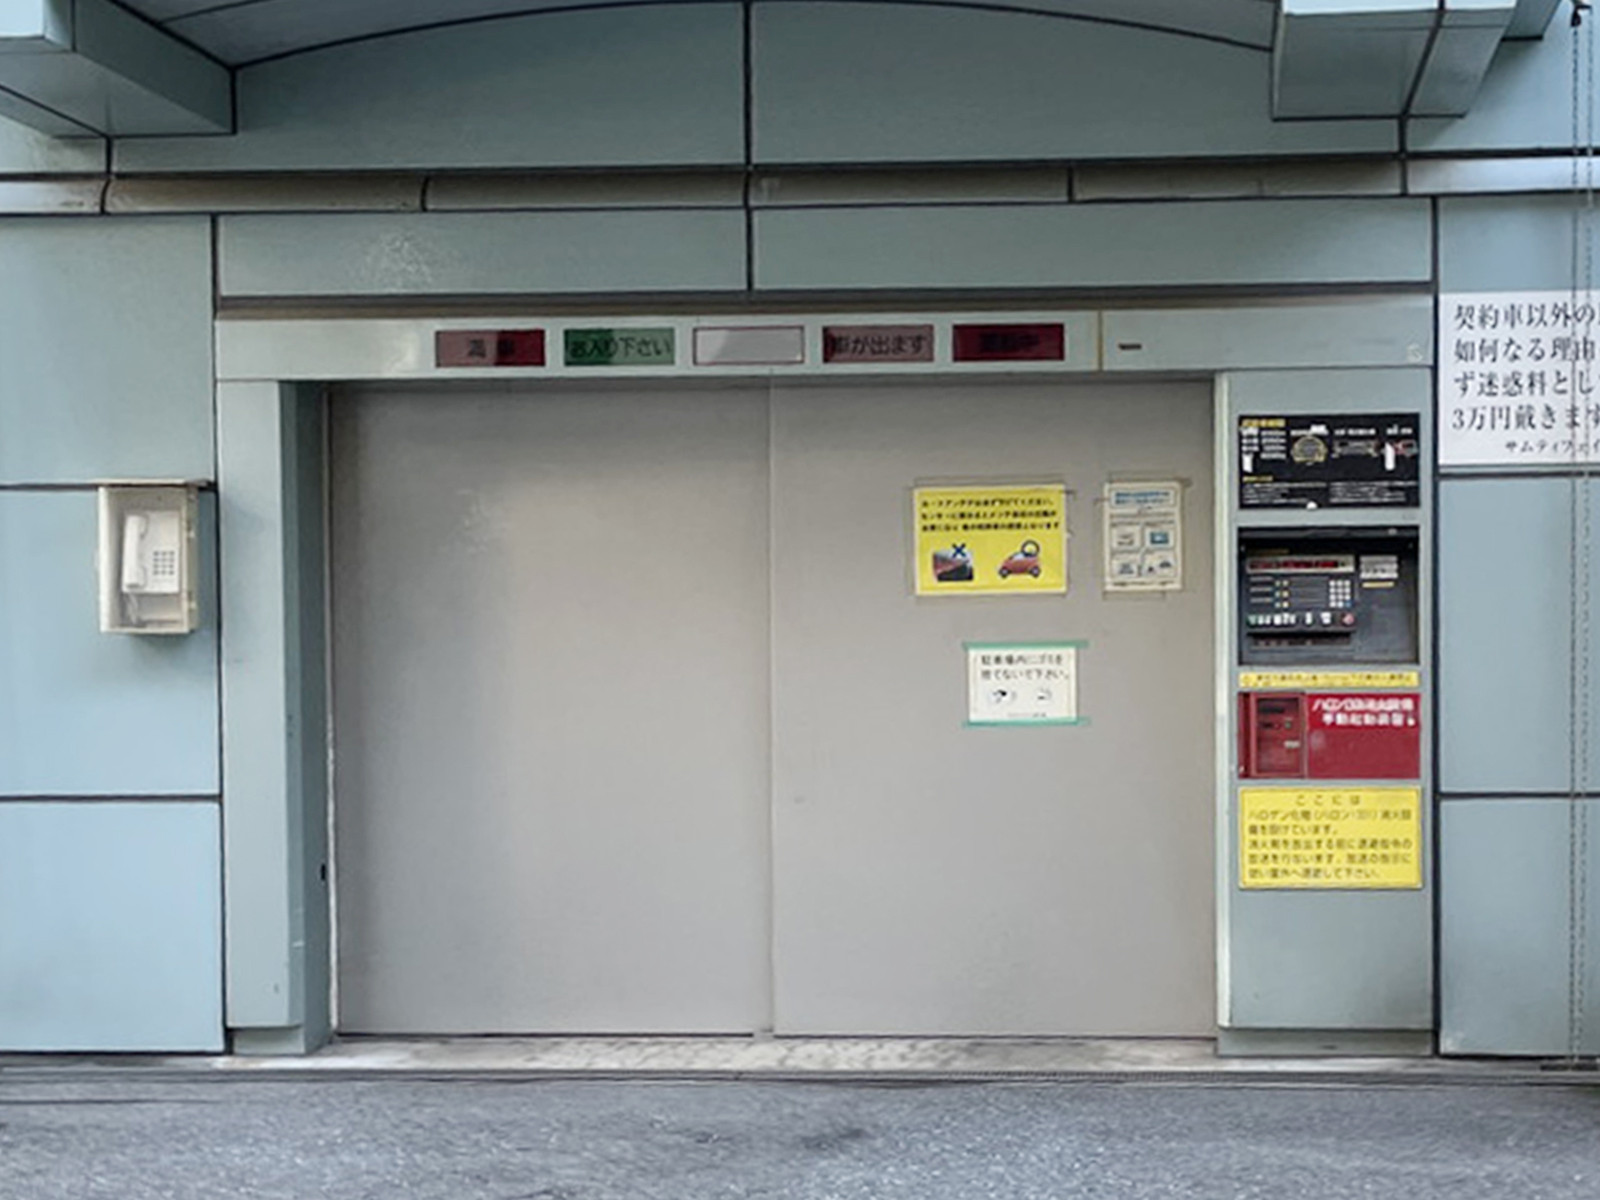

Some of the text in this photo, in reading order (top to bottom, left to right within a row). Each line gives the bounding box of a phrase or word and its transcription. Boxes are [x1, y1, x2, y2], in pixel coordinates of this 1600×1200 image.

[1454, 302, 1600, 331] 契約車以外の
[570, 336, 671, 358] お入り下さい
[1454, 337, 1596, 363] 如何なる理由
[1453, 370, 1600, 397] ず迷惑料とし
